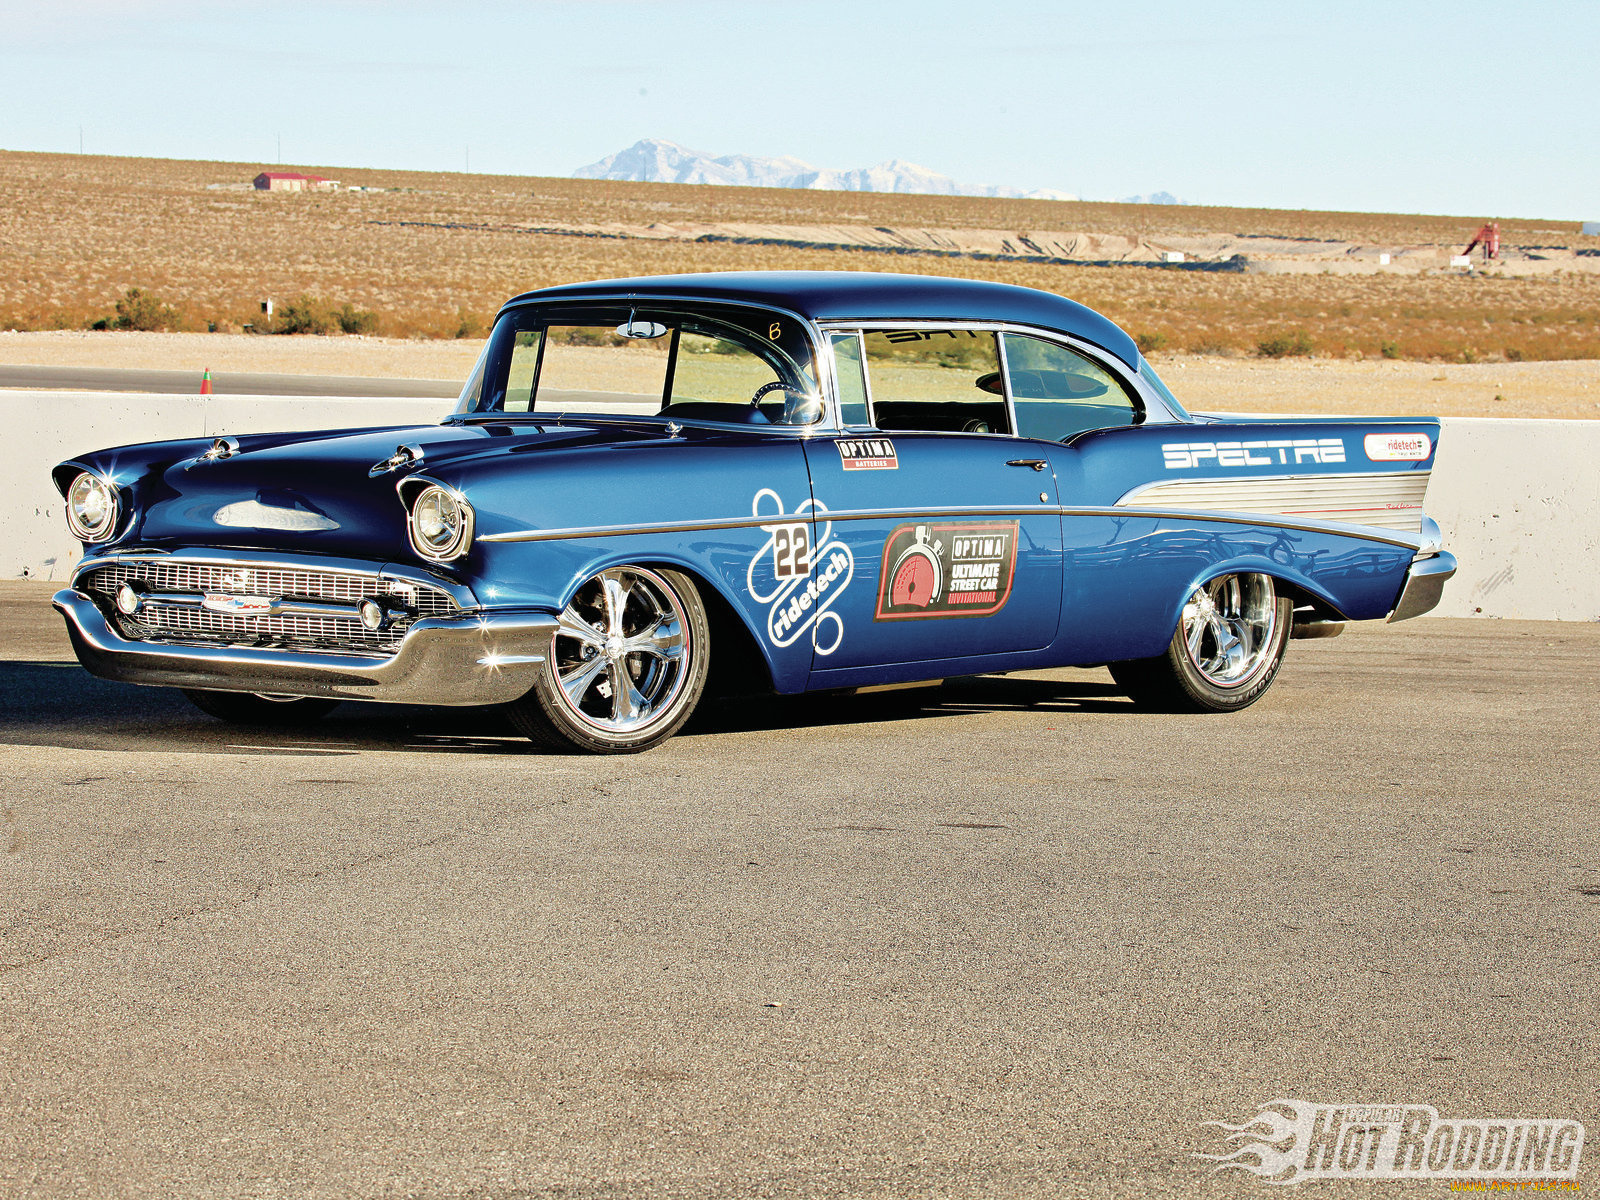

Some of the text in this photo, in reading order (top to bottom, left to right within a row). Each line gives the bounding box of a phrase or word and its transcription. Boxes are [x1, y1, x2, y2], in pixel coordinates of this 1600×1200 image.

[839, 441, 894, 457] OPTIMA
[1388, 440, 1417, 450] ridetech
[1162, 438, 1346, 469] SPECTRE
[776, 527, 809, 575] 22
[954, 539, 1002, 557] OPTIMA
[952, 563, 1000, 578] ULTIMATE
[950, 578, 998, 592] STREET CAR
[774, 551, 849, 638] ridetech
[948, 590, 997, 604] INVITATIONAL
